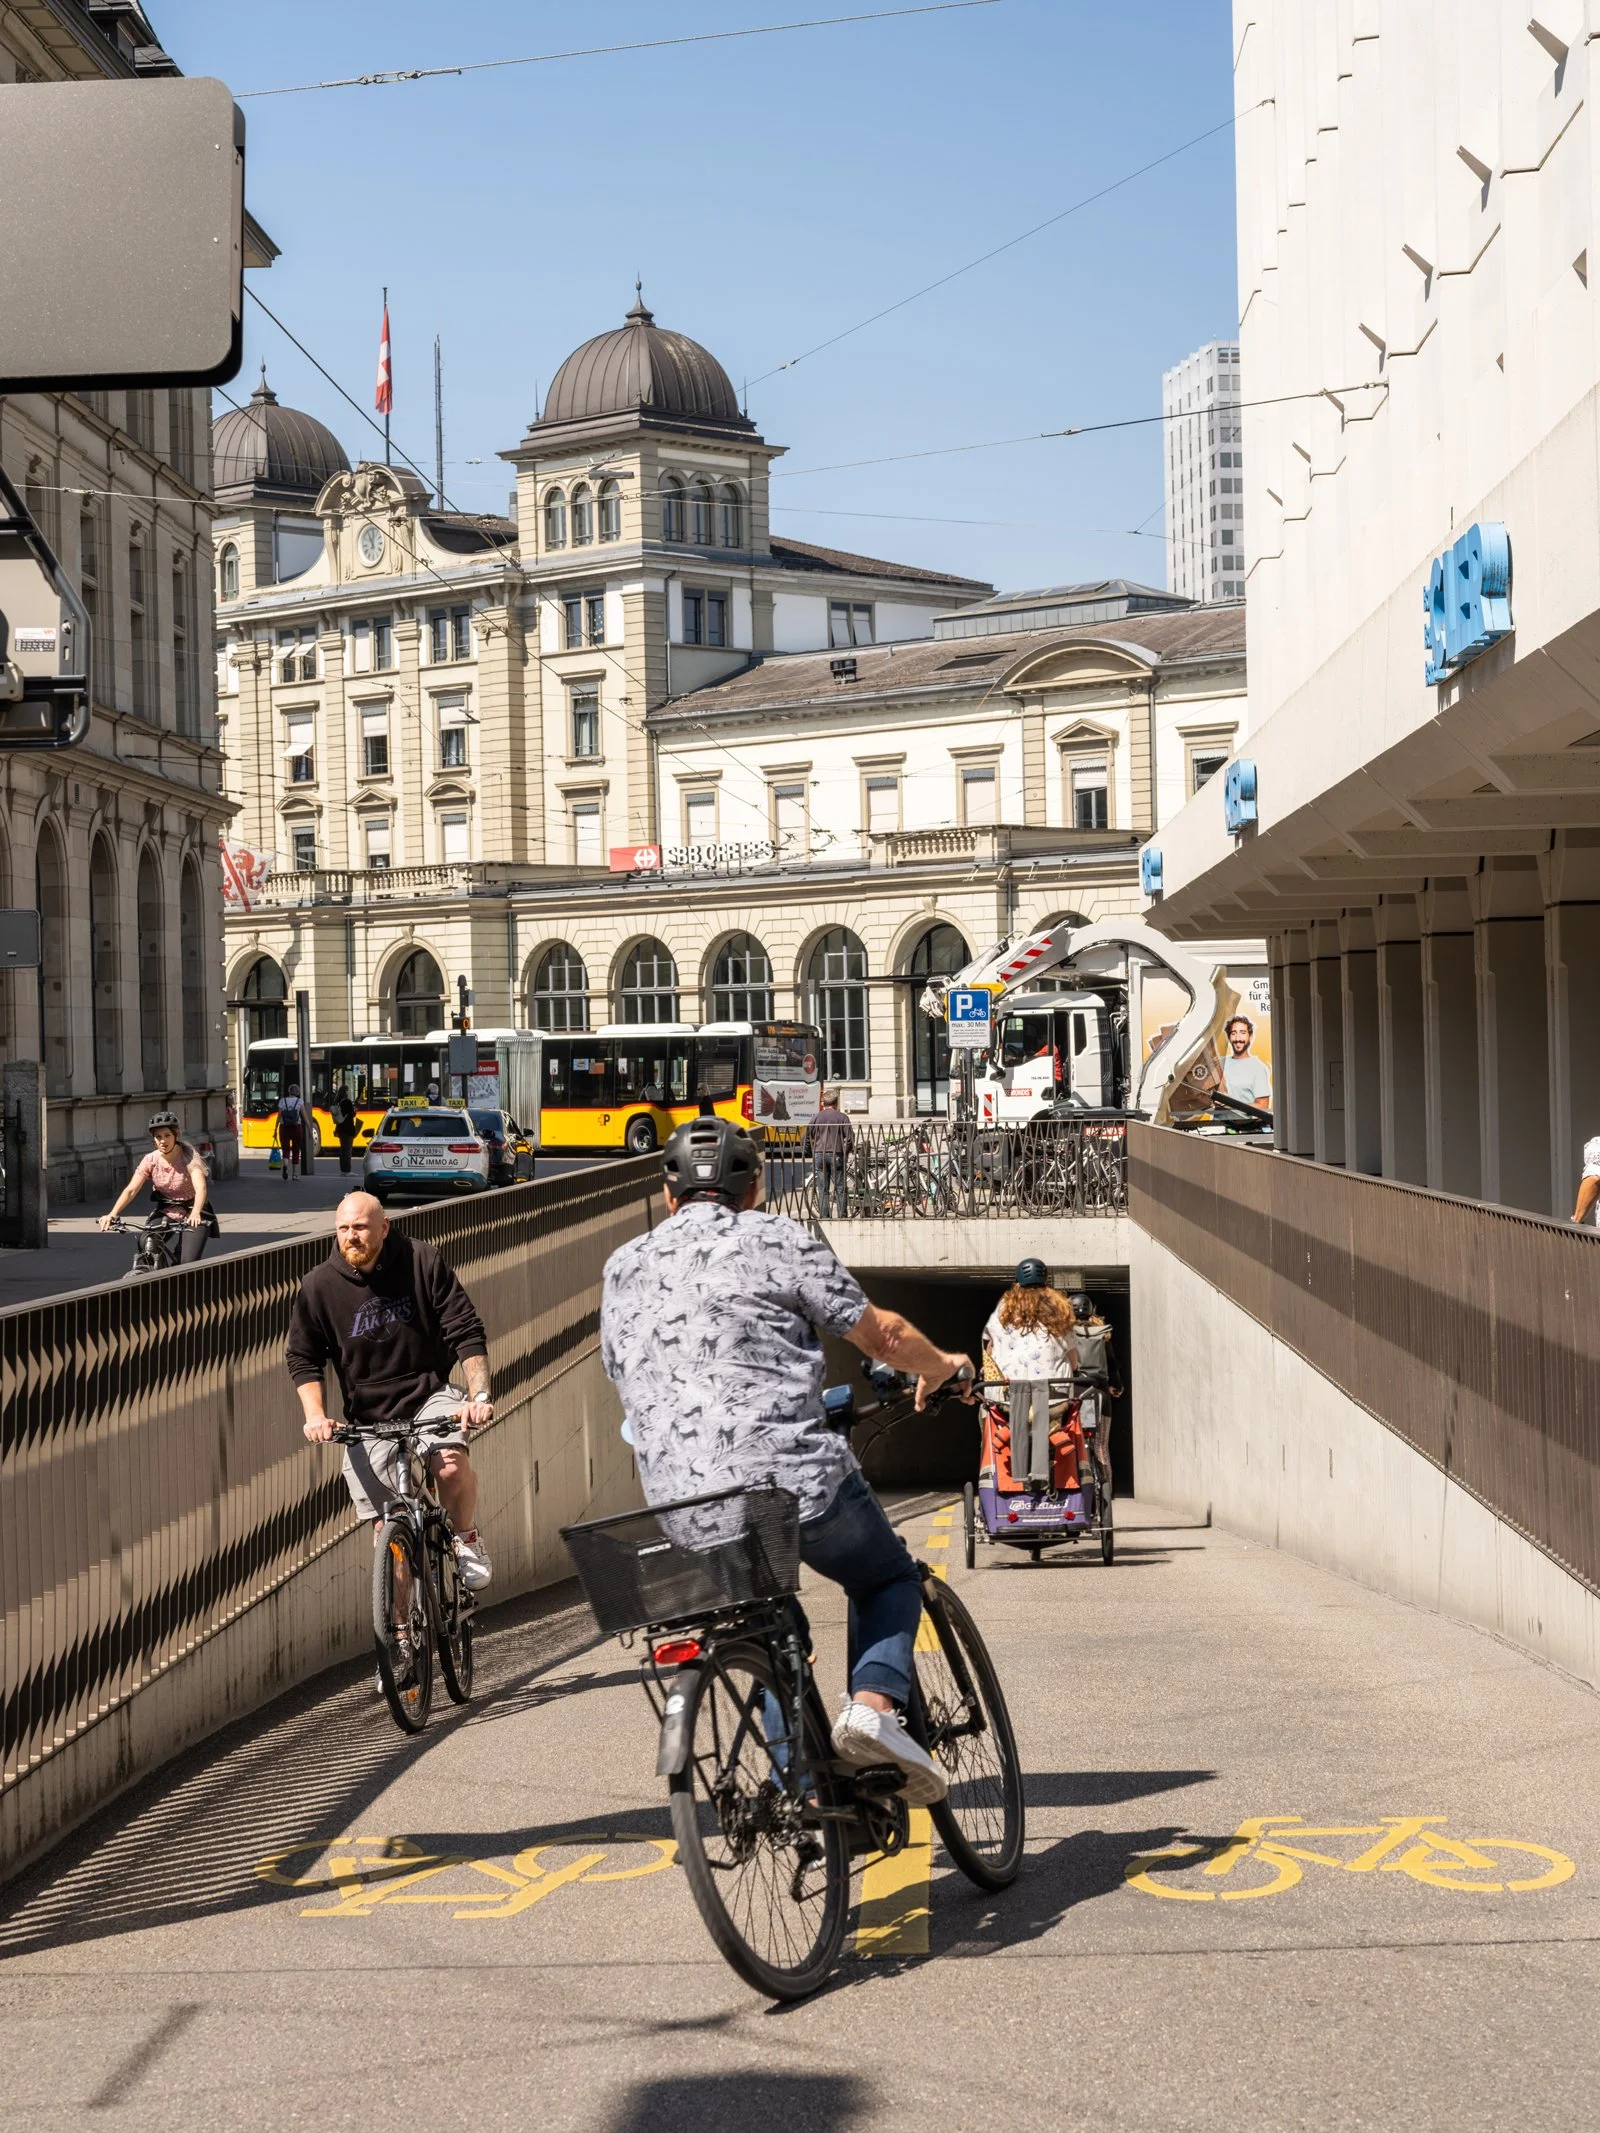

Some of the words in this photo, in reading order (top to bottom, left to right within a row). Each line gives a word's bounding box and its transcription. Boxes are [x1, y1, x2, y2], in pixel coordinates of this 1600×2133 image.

[668, 845, 700, 864] SBB
[1249, 991, 1261, 1001] für
[956, 994, 973, 1019] P
[448, 1158, 459, 1166] AG
